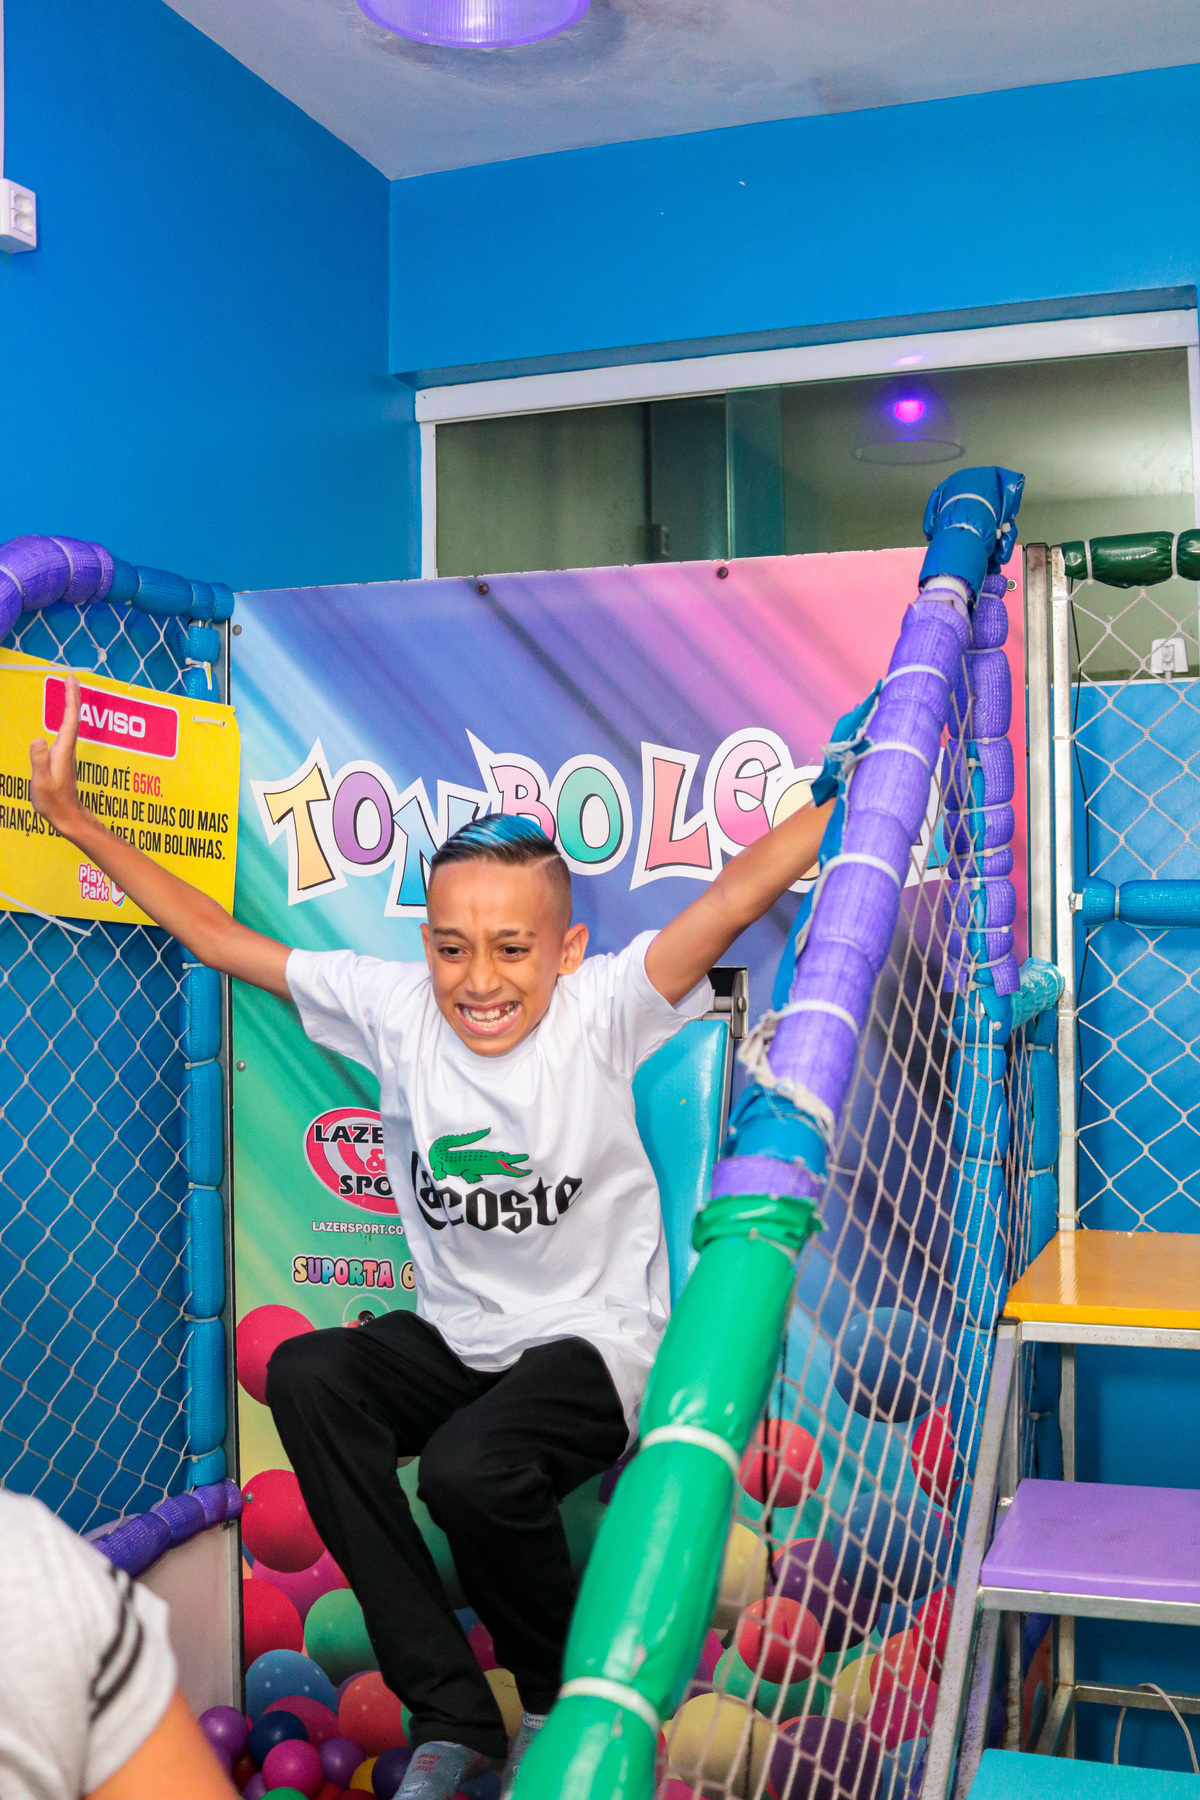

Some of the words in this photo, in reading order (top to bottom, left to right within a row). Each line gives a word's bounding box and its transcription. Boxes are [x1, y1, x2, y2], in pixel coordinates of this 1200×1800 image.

[79, 703, 146, 738] AVISO
[111, 766, 130, 792] ATÉ
[133, 772, 163, 798] 65KG.
[0, 773, 31, 802] ROIBI
[79, 789, 129, 820] ANÊNCIA
[132, 800, 145, 823] DE
[148, 803, 176, 828] DUAS
[179, 808, 195, 830] OU
[198, 810, 229, 834] MAIS
[0, 804, 45, 837] RIANÇAS
[138, 829, 162, 853] COM
[164, 833, 226, 861] BOLINHAS.
[79, 863, 105, 886] Play
[81, 881, 109, 902] Park
[314, 1124, 384, 1144] LAZE
[339, 1174, 394, 1196] SPO
[311, 1220, 405, 1236] LAZERSPORT.CO
[293, 1255, 395, 1289] SUPORTA
